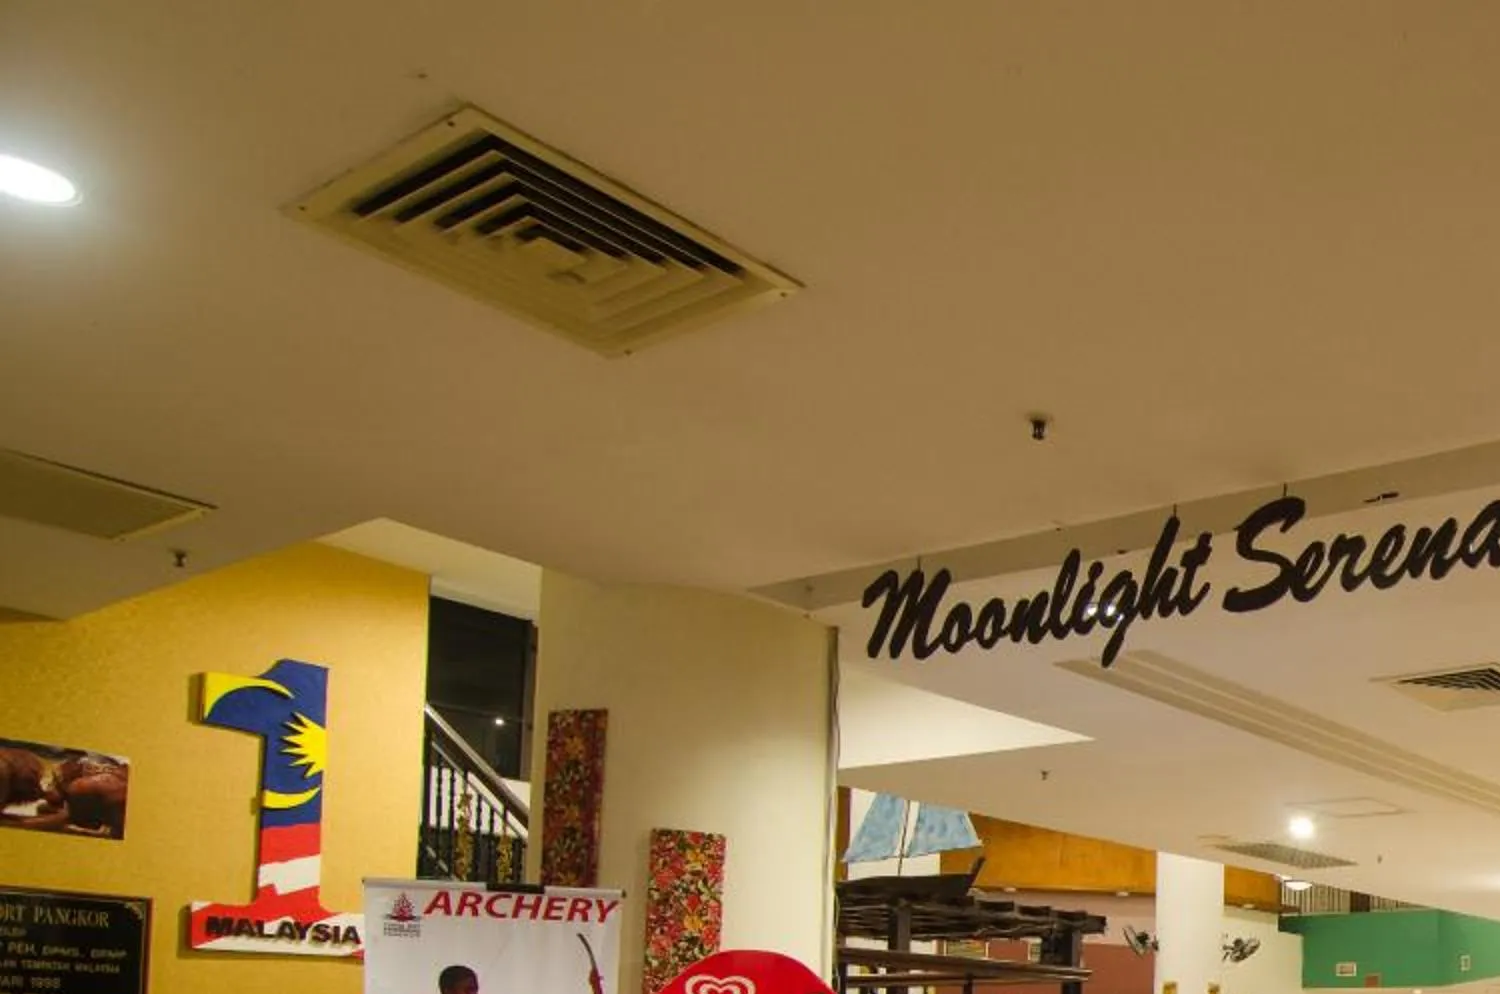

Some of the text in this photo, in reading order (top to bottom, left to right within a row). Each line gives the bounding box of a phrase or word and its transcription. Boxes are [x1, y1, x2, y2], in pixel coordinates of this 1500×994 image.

[862, 514, 1212, 667] Moonlight
[33, 904, 110, 928] PANGKOR
[424, 889, 621, 924] ARCHERY
[203, 915, 361, 946] MALAYSIA
